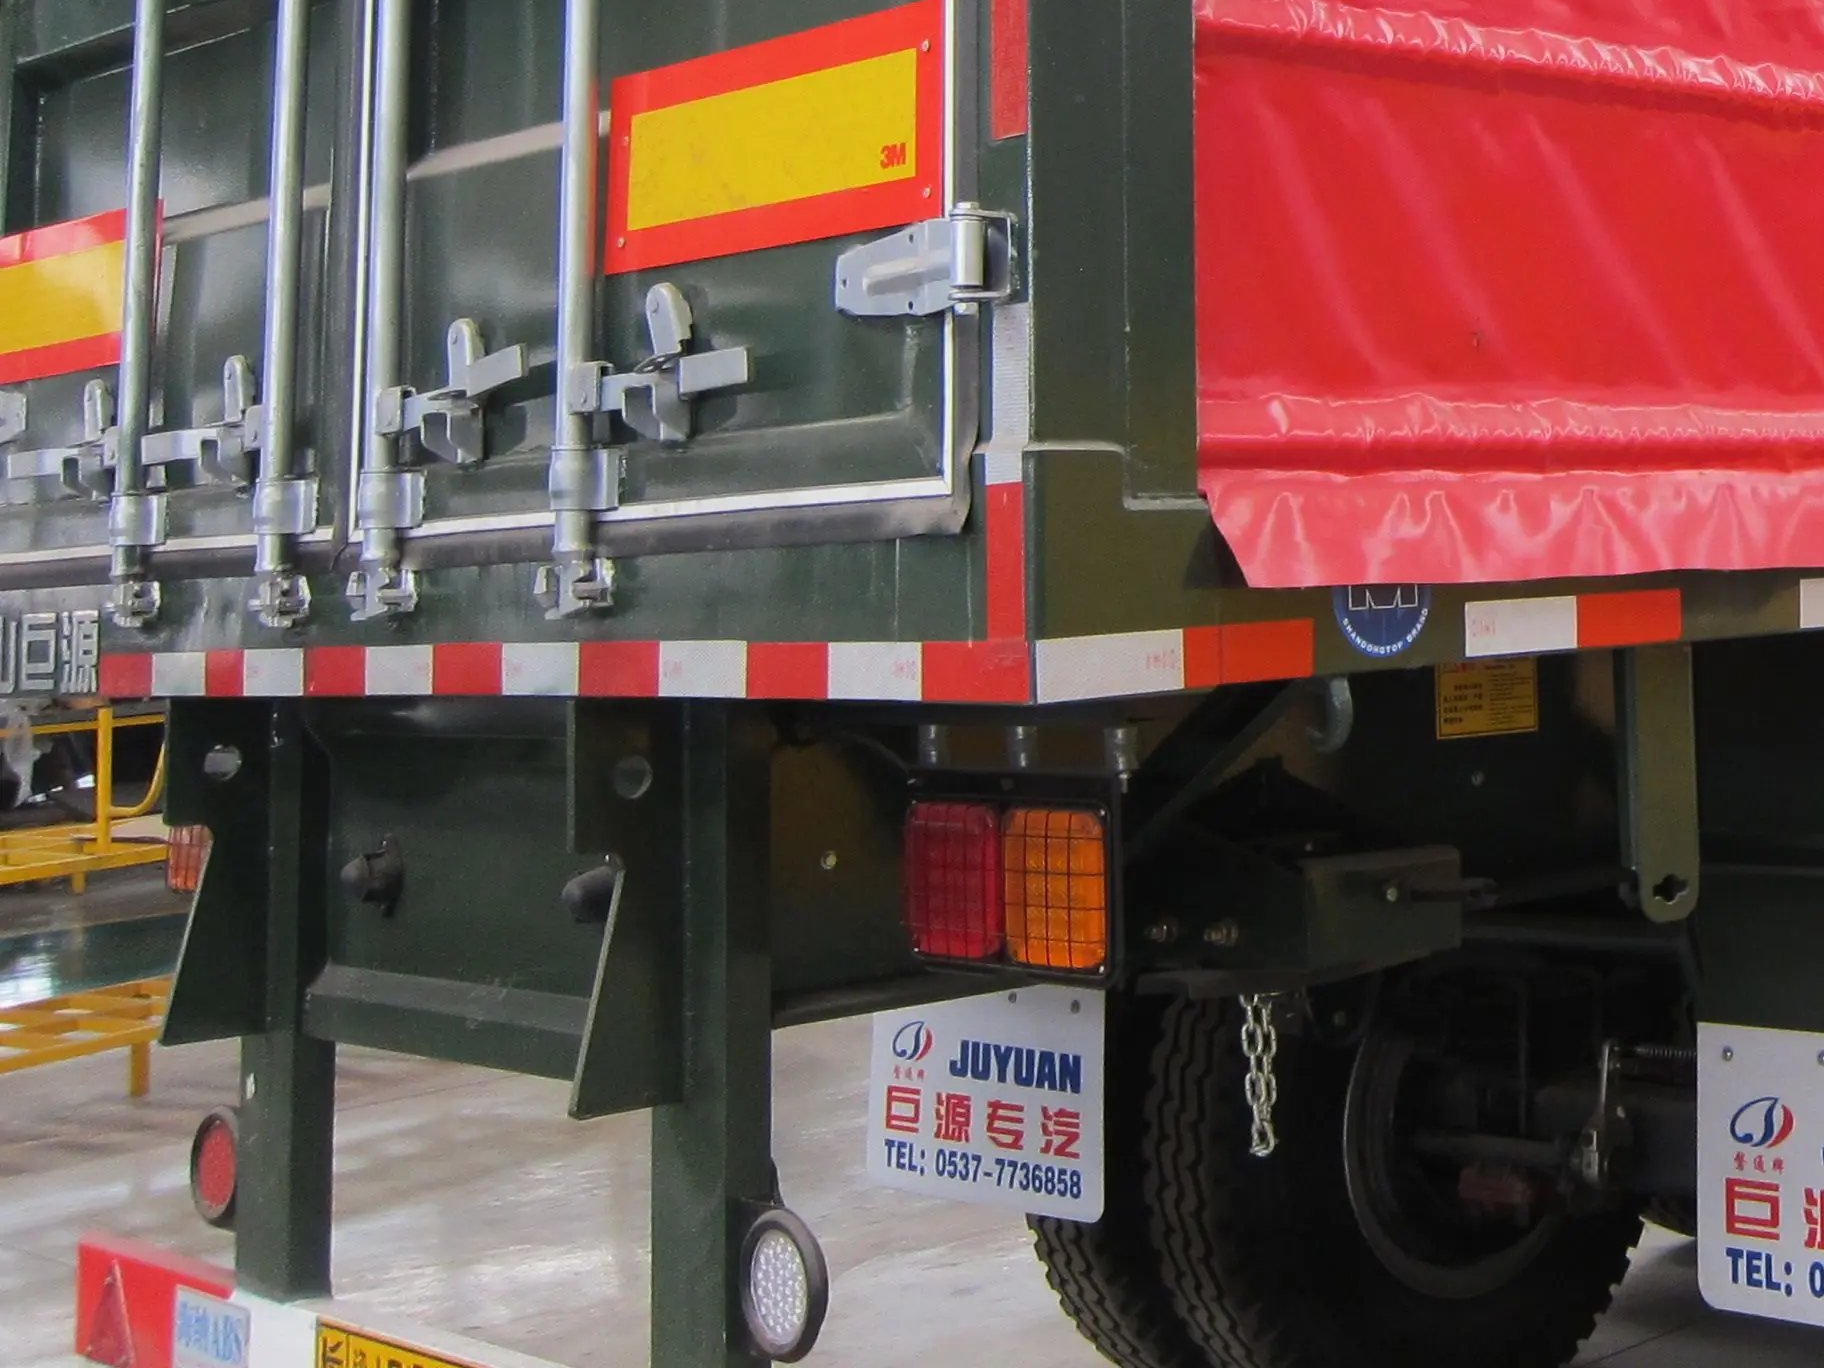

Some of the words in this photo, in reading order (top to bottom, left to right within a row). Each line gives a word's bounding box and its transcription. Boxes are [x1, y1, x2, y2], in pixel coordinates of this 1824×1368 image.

[880, 142, 906, 170] 3M
[1406, 607, 1428, 643] BRAND
[949, 1039, 1082, 1094] JUYUAN
[885, 1085, 1081, 1159] 巨源专汽
[885, 1138, 926, 1176] TEL:
[935, 1148, 1082, 1199] 0537-7736858
[1726, 1247, 1792, 1297] TEL:
